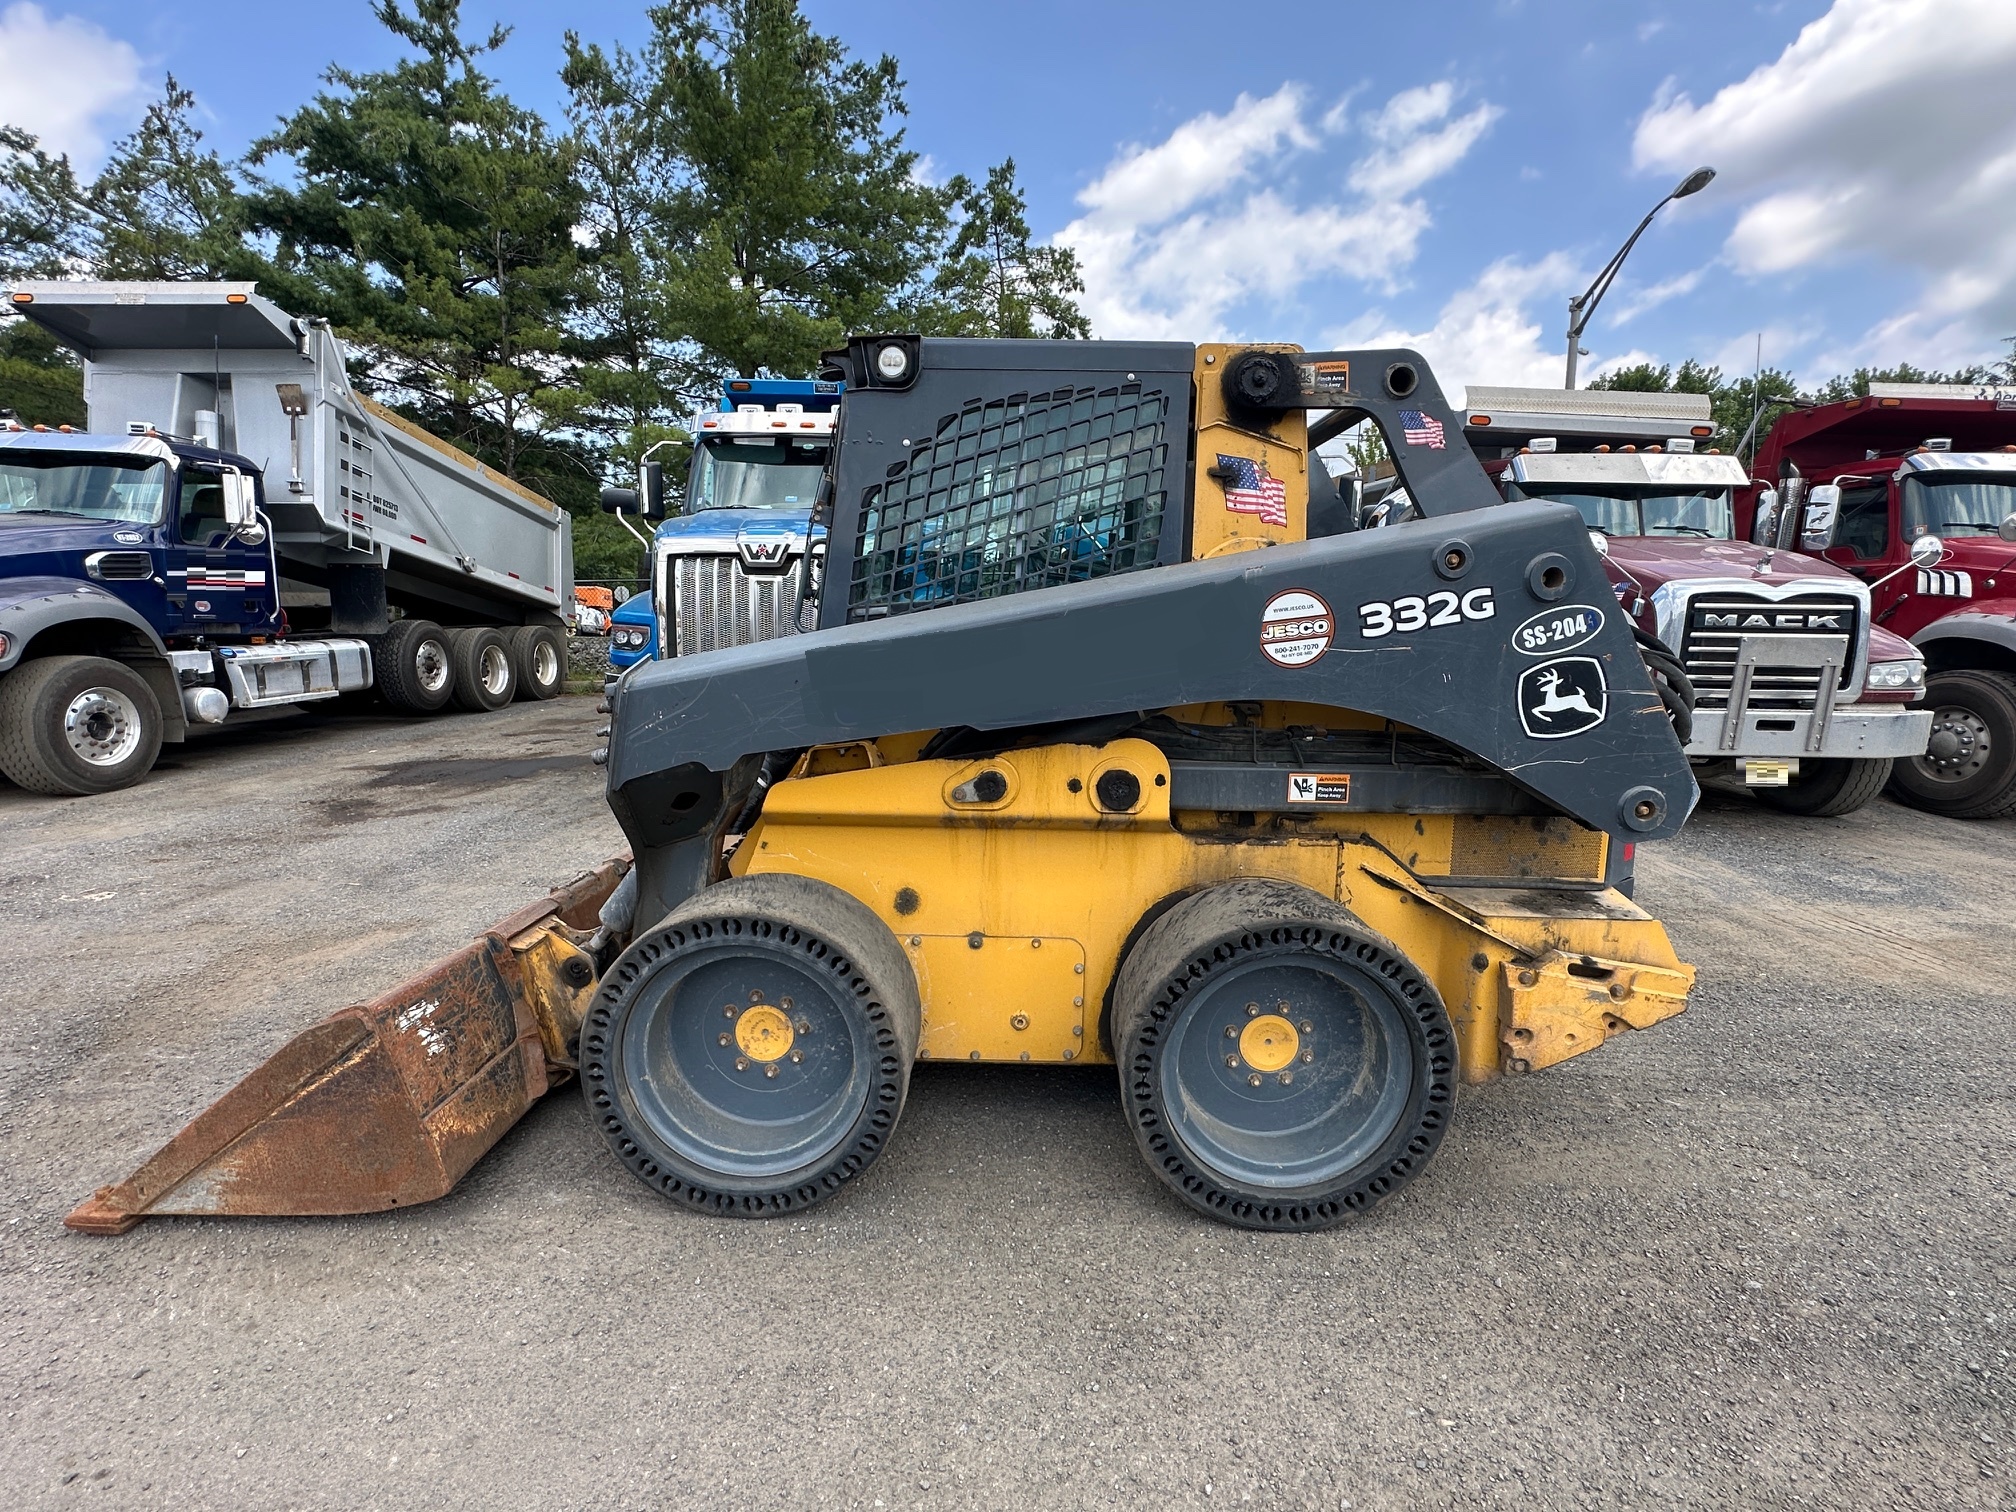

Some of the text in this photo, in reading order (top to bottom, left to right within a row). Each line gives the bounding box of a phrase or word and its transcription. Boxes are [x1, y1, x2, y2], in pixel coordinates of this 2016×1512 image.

[1272, 604, 1315, 613] WWW.JESCO.US
[1359, 586, 1496, 638] 332G
[1704, 613, 1841, 628] MACK
[1261, 618, 1331, 641] JESCO
[1274, 643, 1319, 655] 800-241-7070
